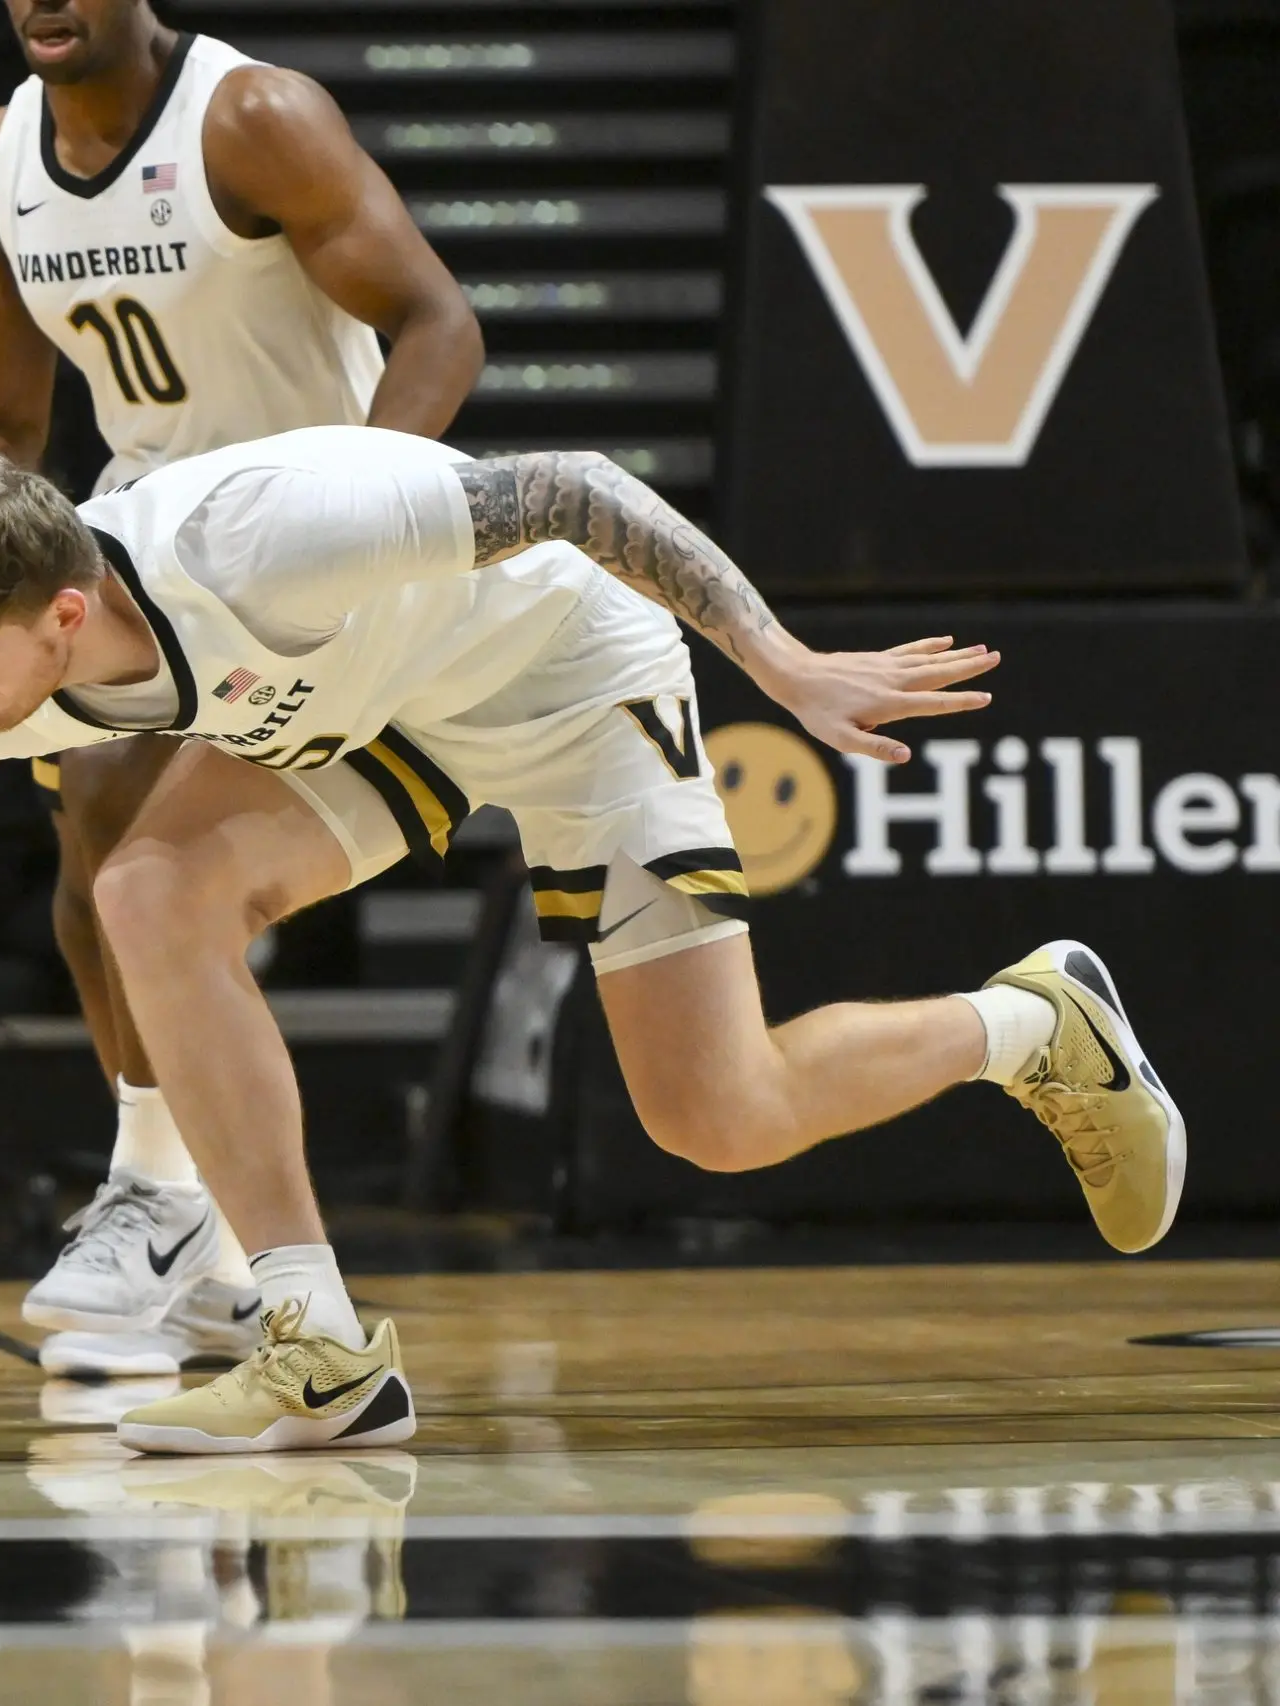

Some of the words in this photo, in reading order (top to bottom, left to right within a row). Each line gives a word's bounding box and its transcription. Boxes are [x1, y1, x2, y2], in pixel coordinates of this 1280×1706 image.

[17, 242, 187, 283] VANDERBILT
[67, 294, 189, 405] 10
[763, 183, 1160, 468] V
[616, 693, 699, 781] V
